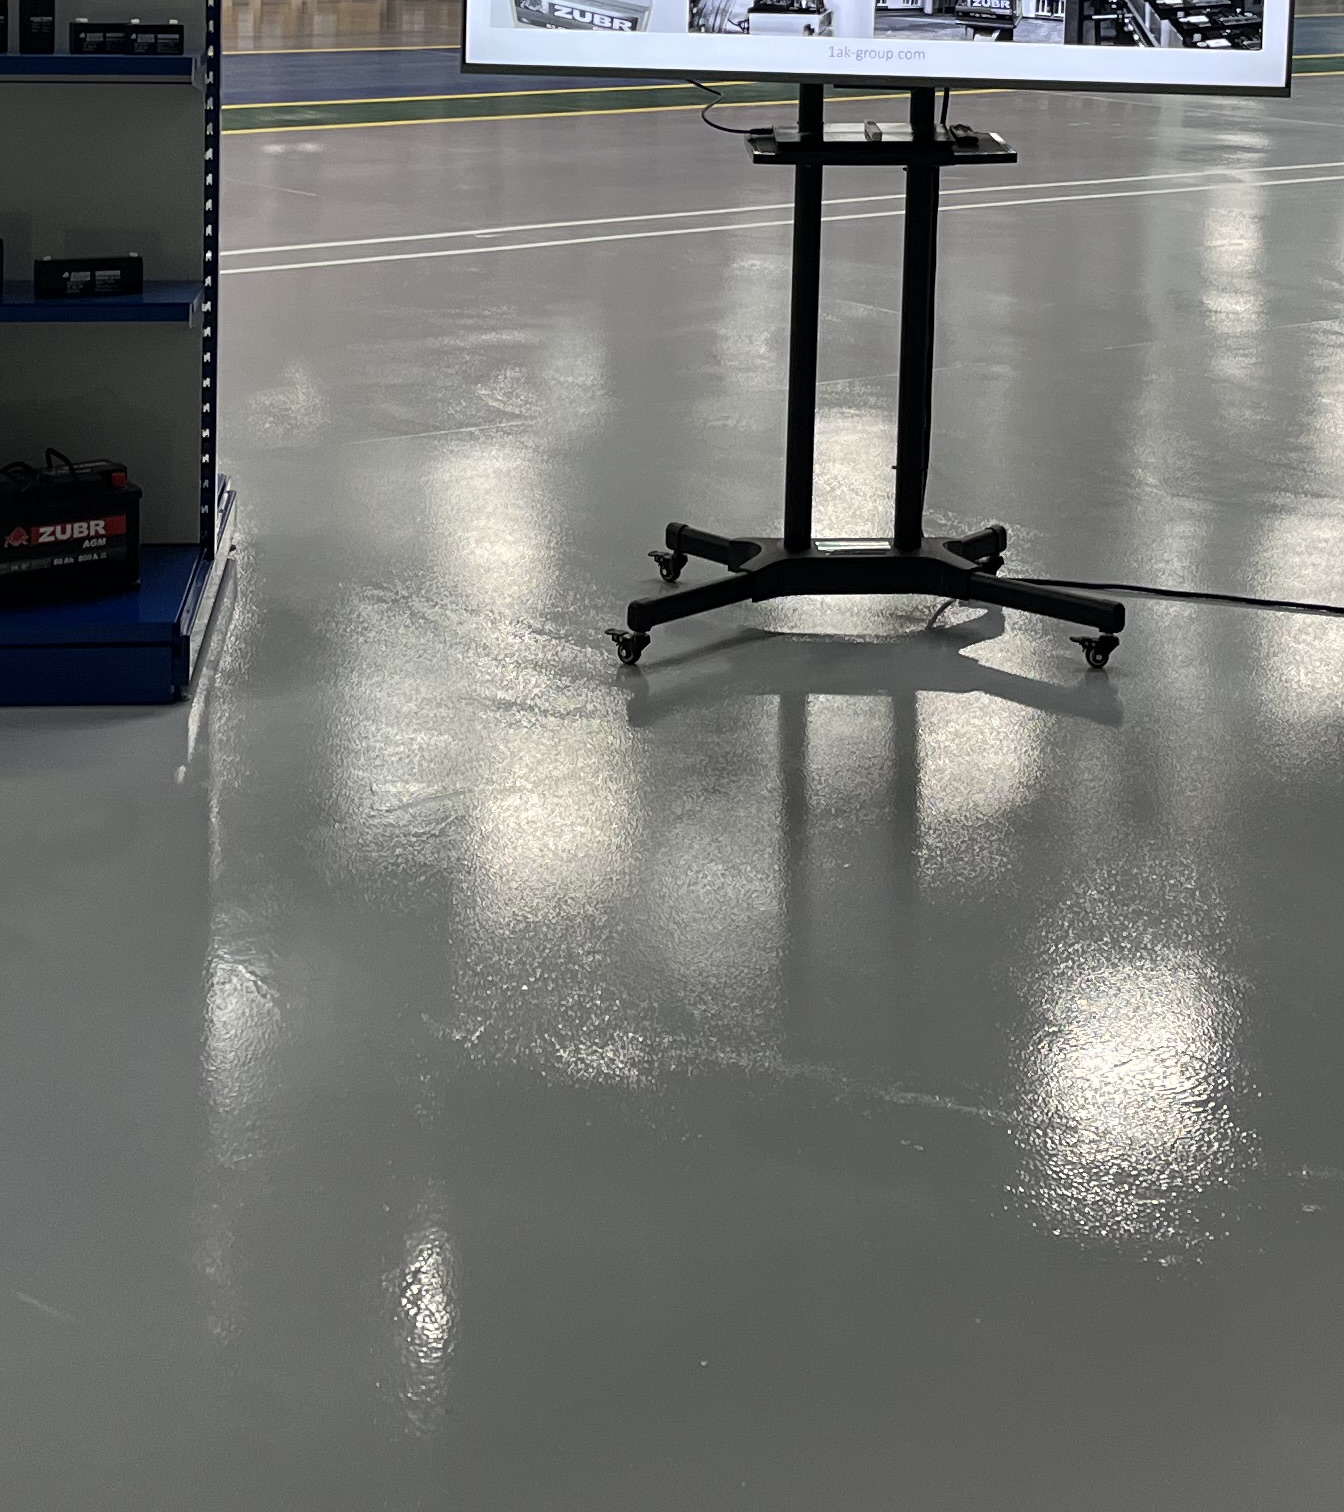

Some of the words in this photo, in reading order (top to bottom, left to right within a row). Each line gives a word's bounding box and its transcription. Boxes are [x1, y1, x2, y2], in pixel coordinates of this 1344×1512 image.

[553, 4, 633, 32] ZUBR
[828, 45, 926, 62] 1ak-group.com
[38, 519, 107, 543] ZUBR
[82, 537, 107, 549] AGM
